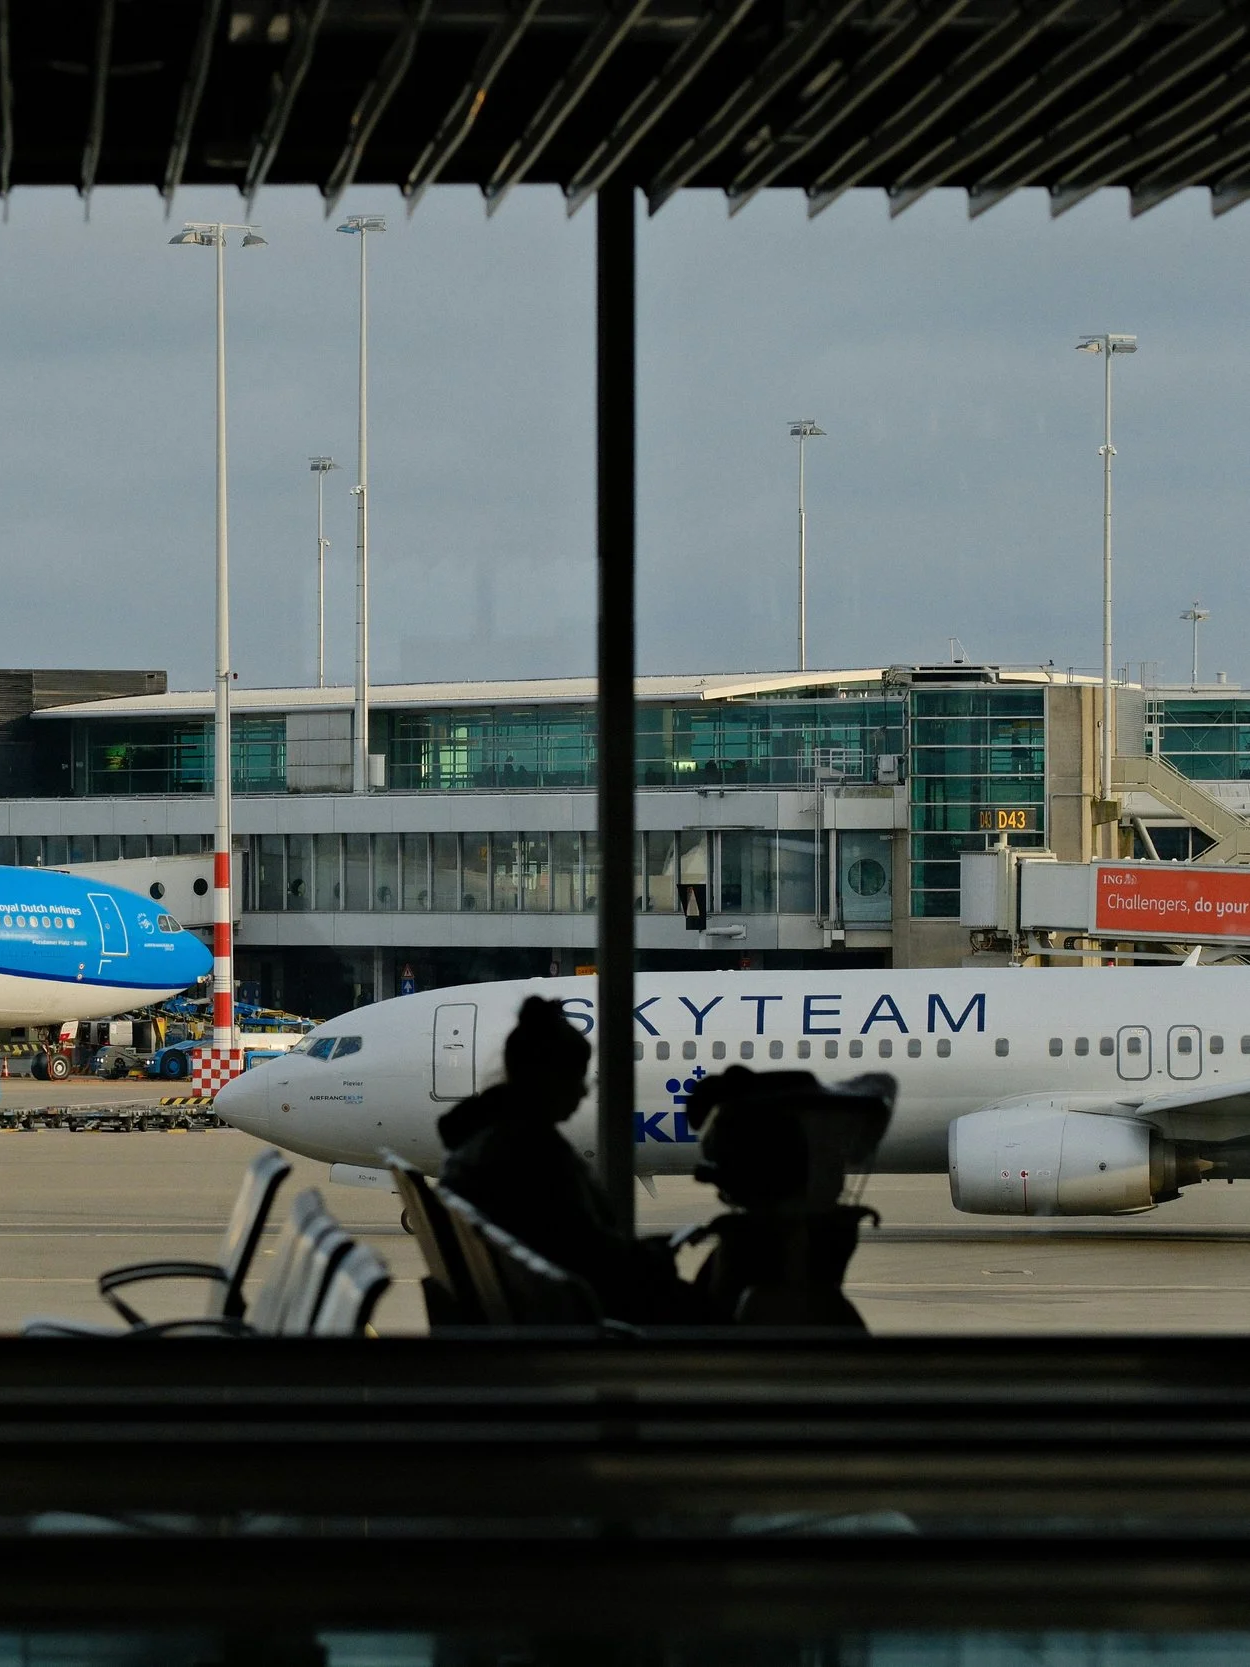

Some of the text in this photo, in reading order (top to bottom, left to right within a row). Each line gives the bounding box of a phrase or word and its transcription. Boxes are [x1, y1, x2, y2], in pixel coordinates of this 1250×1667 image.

[980, 811, 992, 828] D43
[998, 810, 1026, 828] D43
[1103, 875, 1123, 884] ING
[21, 904, 47, 913] Dutch
[49, 905, 82, 916] Airlines
[1107, 893, 1249, 917] Challengers, do your
[561, 993, 986, 1035] SKYTEAM
[633, 1111, 701, 1143] KL
